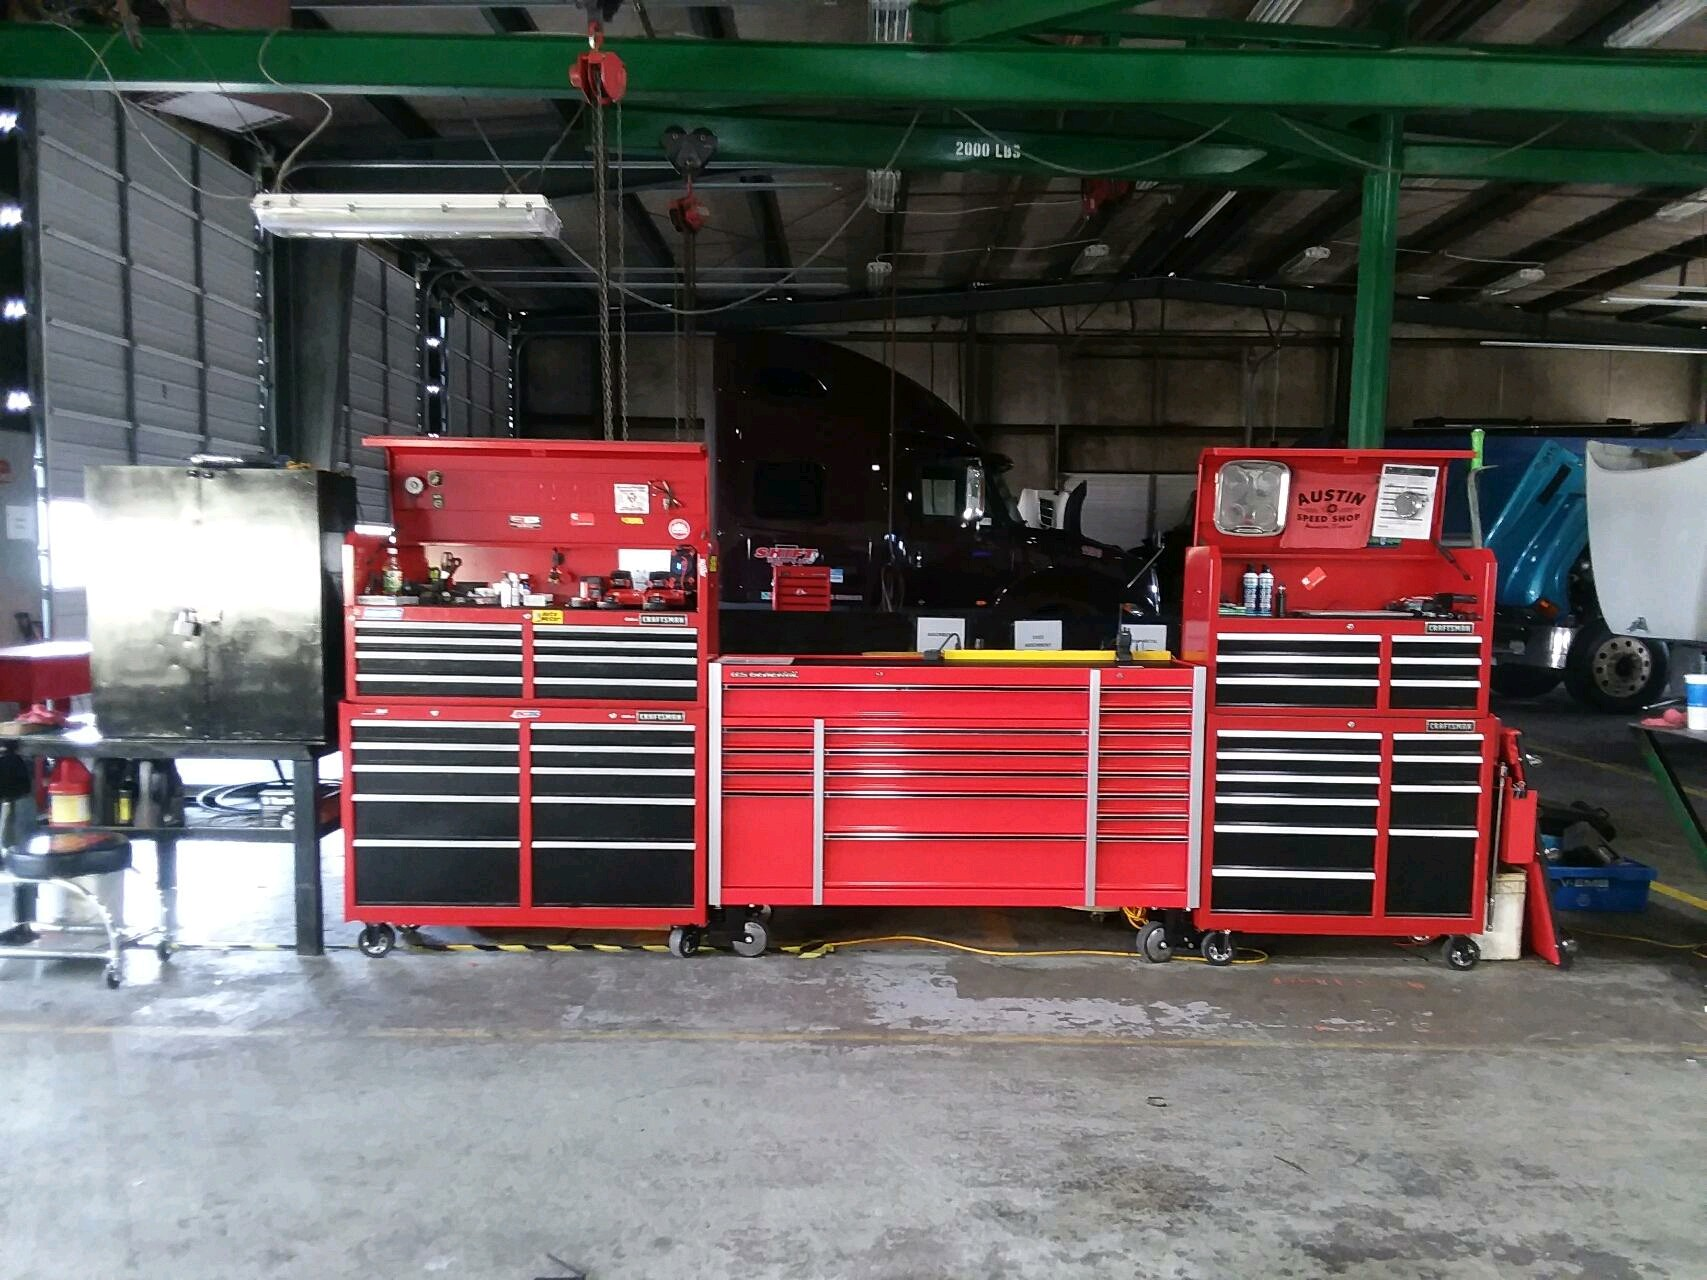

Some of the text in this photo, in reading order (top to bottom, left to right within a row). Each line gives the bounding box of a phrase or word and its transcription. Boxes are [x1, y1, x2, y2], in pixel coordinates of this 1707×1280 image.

[955, 141, 1021, 159] 2000 LBS
[1298, 488, 1367, 506] AUSTIN
[1296, 513, 1361, 523] SPEED SHOP
[1429, 624, 1471, 632] CRAFTSMAN
[1429, 722, 1472, 730] CRAFTSMAN
